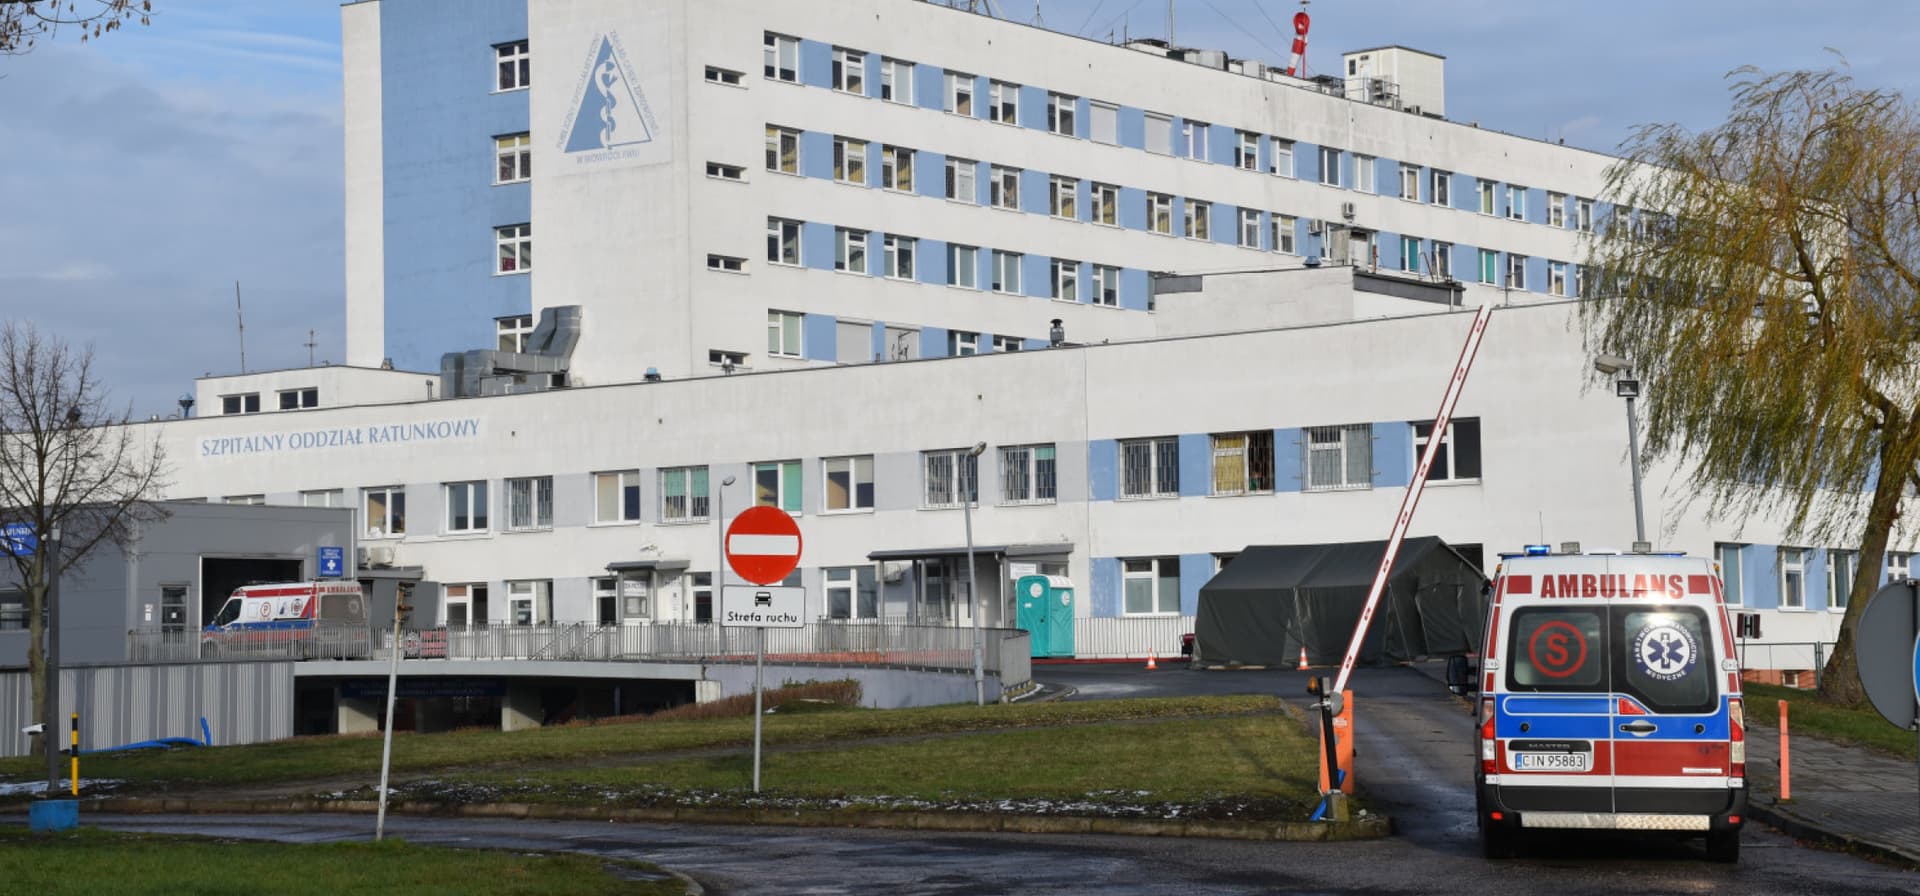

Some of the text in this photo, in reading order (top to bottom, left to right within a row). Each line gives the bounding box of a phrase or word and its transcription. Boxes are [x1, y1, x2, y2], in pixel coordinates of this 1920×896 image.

[202, 418, 480, 456] SZPITALNY ODDZIAŁ RATUNKOWY
[1540, 573, 1684, 599] AMBULANS
[728, 611, 797, 622] Strefa ruchu
[1546, 633, 1568, 666] S
[1523, 755, 1583, 767] CIN 95883
